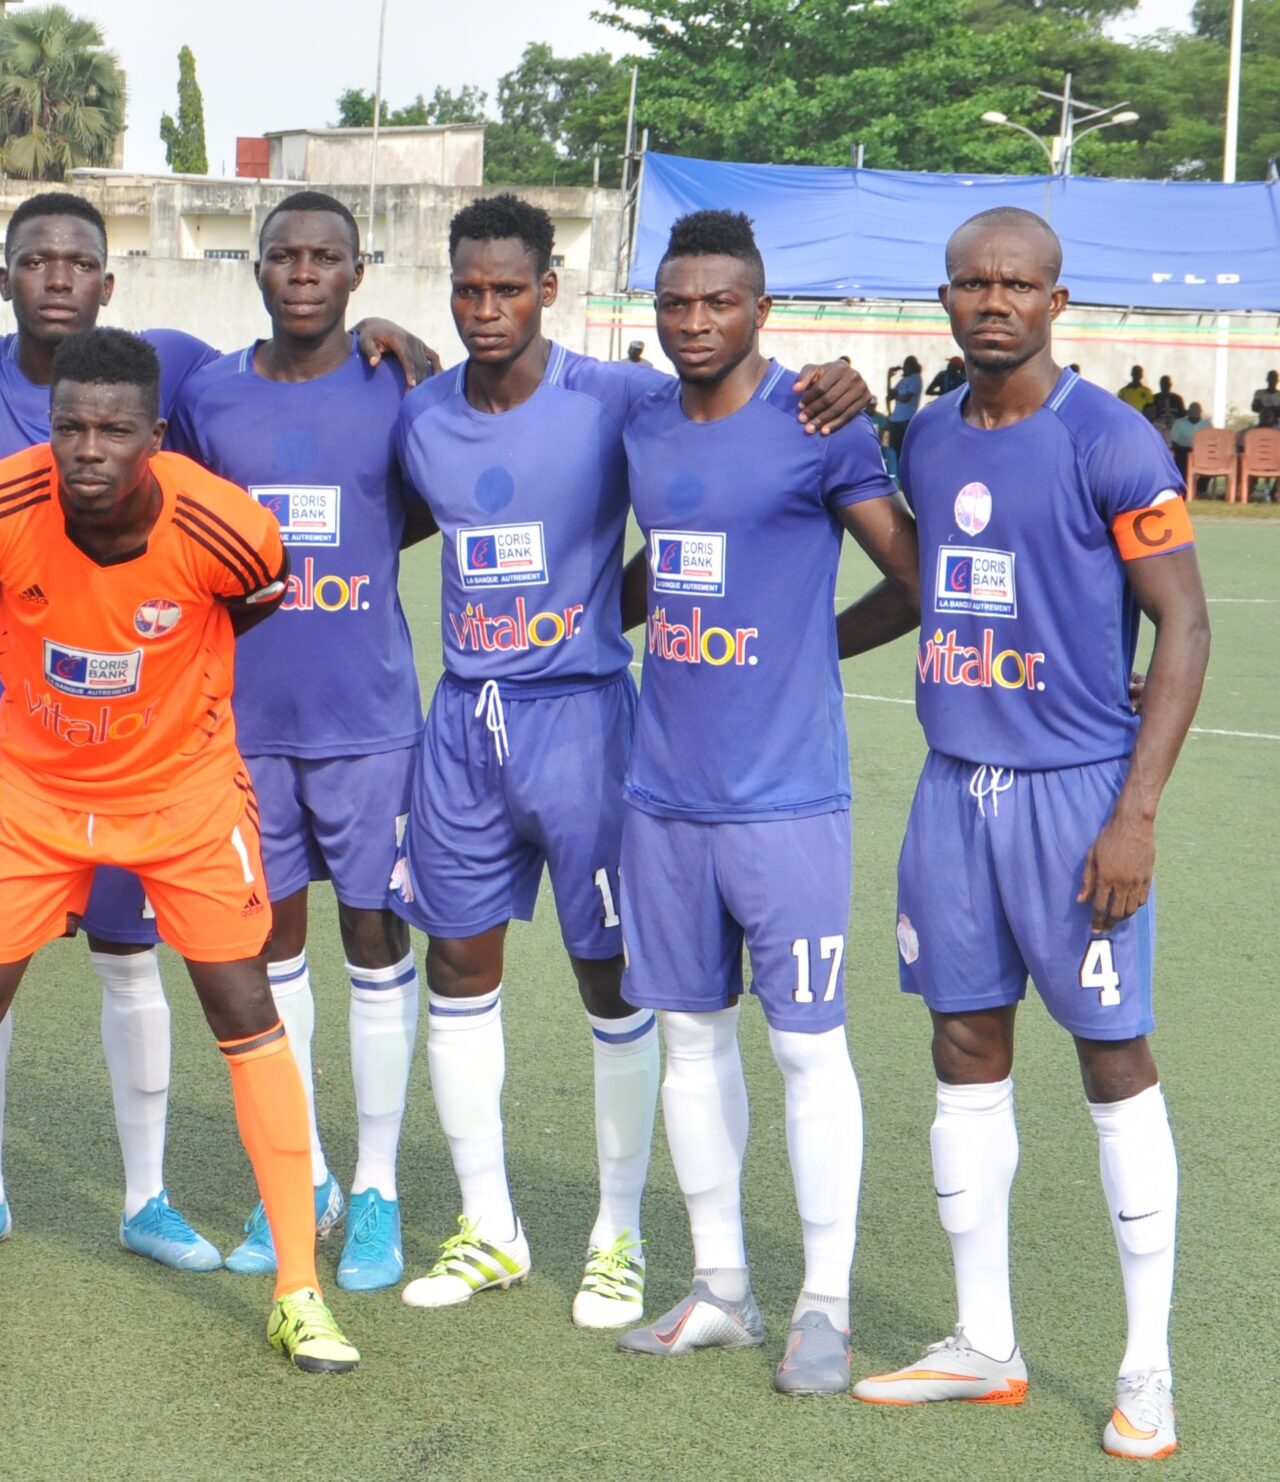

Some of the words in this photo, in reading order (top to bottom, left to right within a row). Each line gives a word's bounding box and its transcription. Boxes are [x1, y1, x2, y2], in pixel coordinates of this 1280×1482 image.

[292, 494, 326, 507] CORIS
[292, 508, 326, 518] BANK
[1133, 510, 1172, 546] C
[498, 533, 531, 546] CORIS
[499, 547, 532, 559] BANK
[684, 542, 713, 554] CORIS
[683, 556, 712, 568] BANK
[974, 558, 1006, 574] CORIS
[973, 574, 1006, 588] BANK
[90, 660, 128, 669] CORIS
[89, 670, 127, 678] BANK
[231, 825, 254, 884] 1
[594, 867, 621, 929] 1
[792, 935, 844, 1003] 17
[1081, 939, 1121, 1007] 4
